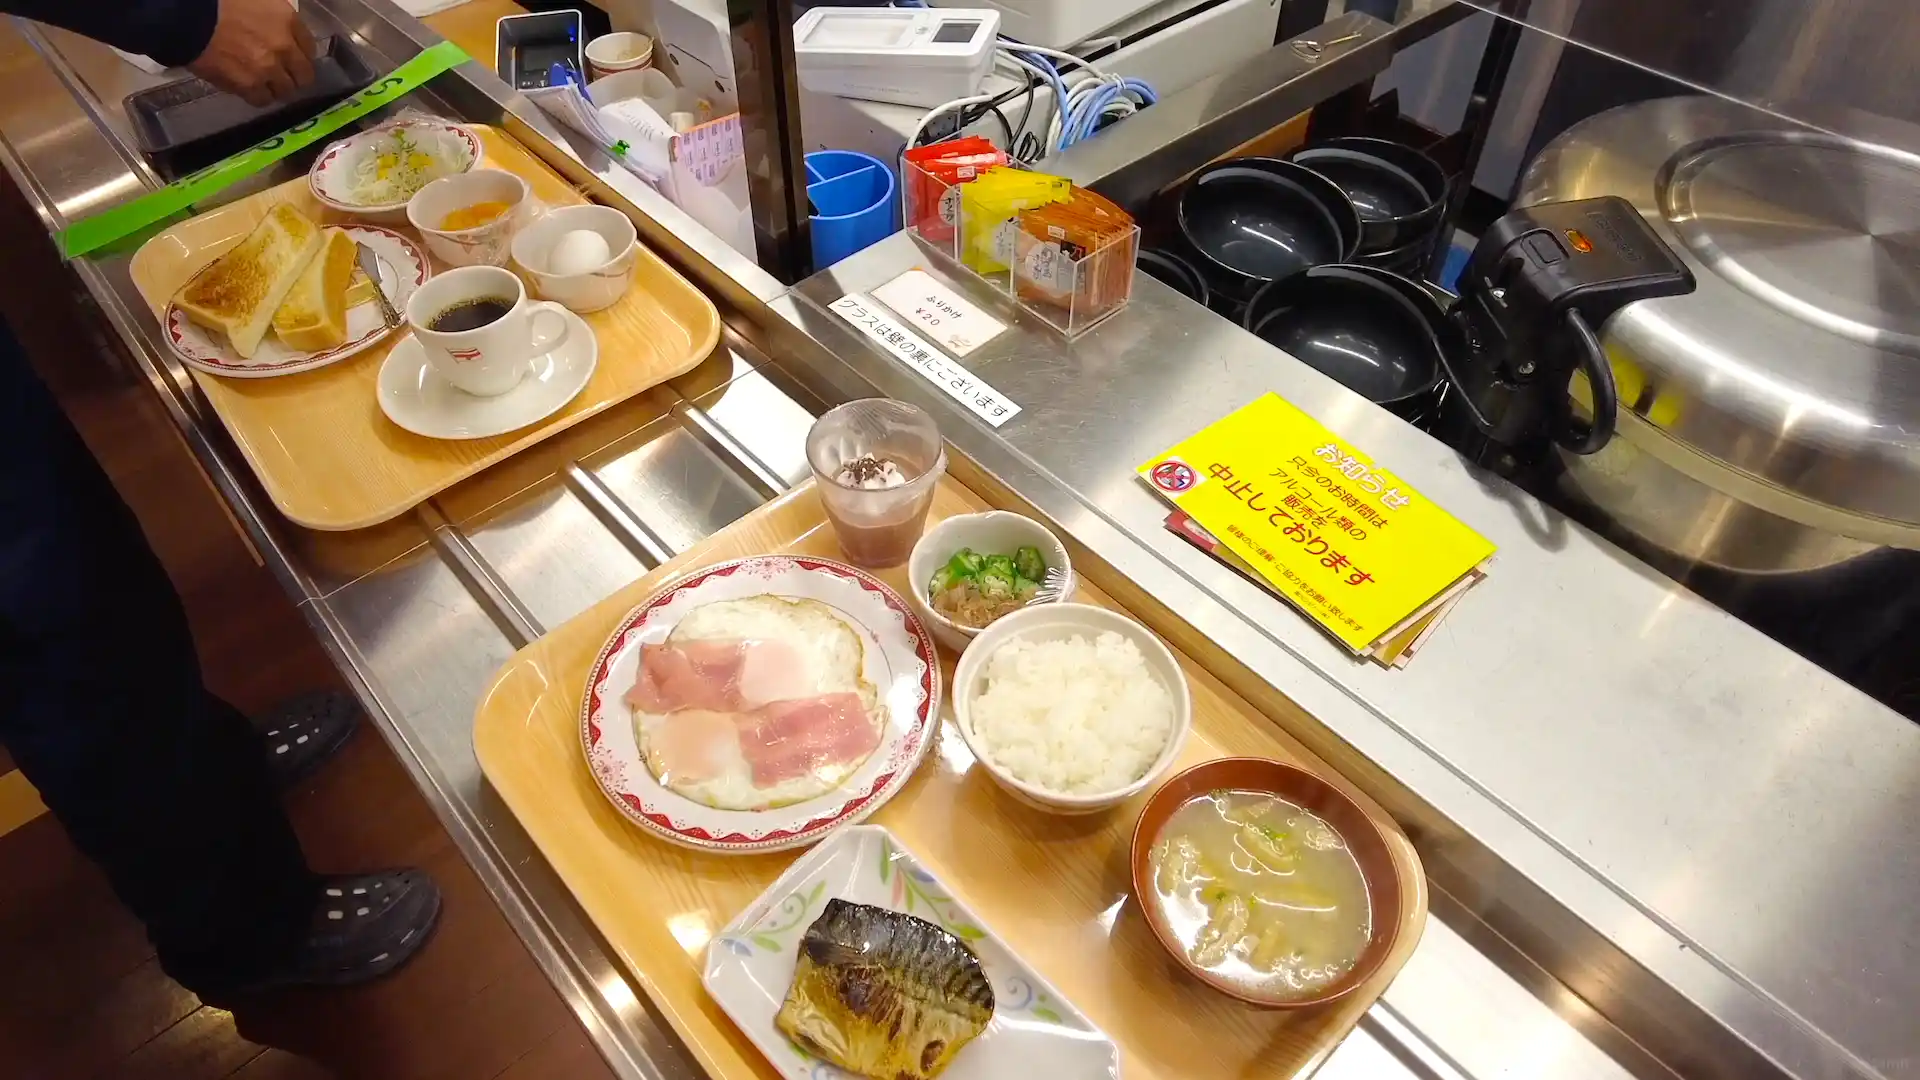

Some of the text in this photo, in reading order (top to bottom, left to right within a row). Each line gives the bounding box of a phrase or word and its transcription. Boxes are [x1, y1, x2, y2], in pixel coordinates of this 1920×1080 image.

[915, 307, 940, 326] ¥20
[926, 294, 964, 320] ふりかけ
[837, 299, 1009, 417] グラスは壁の裏にございます
[1269, 467, 1368, 542] アルコール類の
[1281, 494, 1329, 531] 販売を
[1287, 455, 1390, 530] 只今のお時間は
[1311, 442, 1411, 511] お知らせ
[1207, 462, 1377, 587] 中止しております
